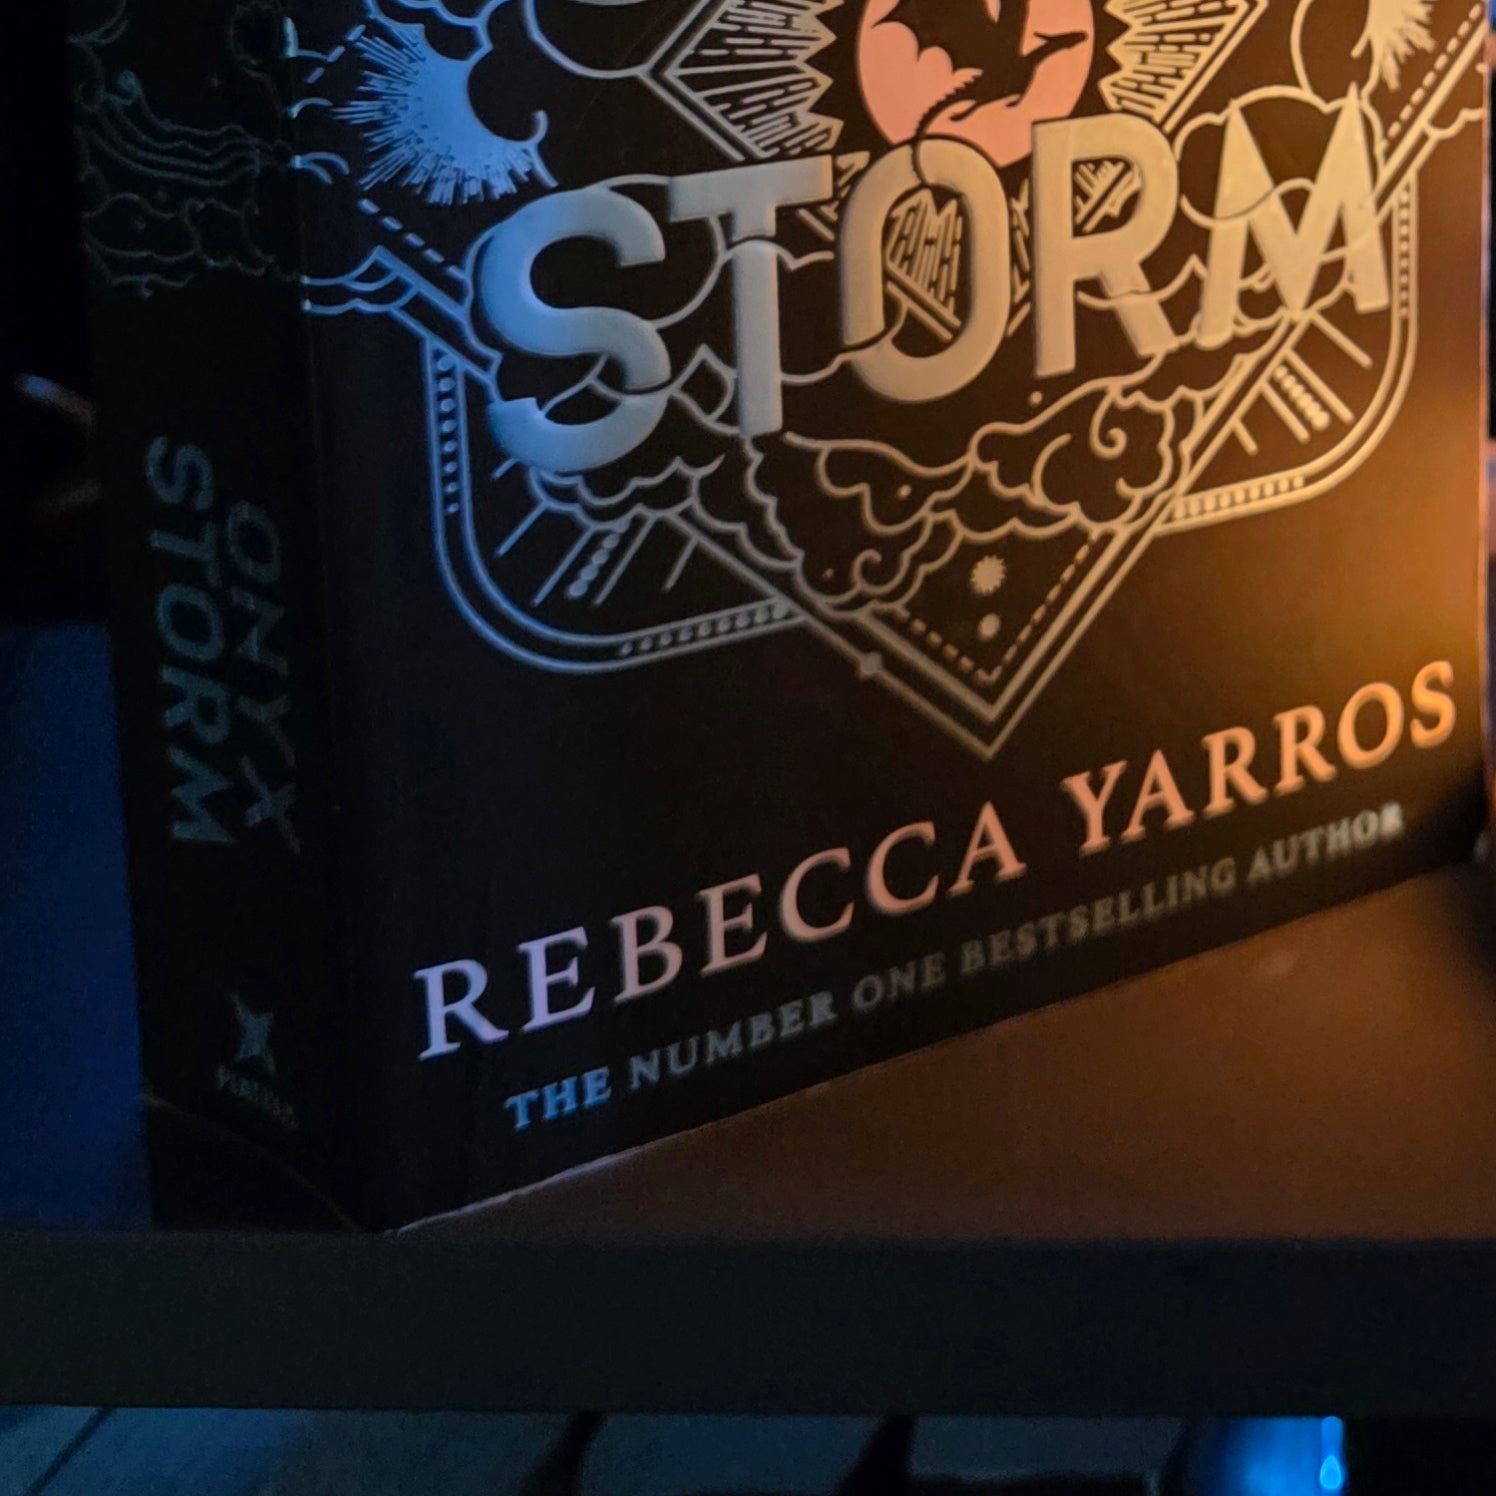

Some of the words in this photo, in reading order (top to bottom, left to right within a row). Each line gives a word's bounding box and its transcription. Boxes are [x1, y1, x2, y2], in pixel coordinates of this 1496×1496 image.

[472, 81, 1392, 473] STORM
[145, 434, 236, 846] STORM
[413, 799, 1027, 1061] REBECCA
[1060, 659, 1456, 858] YARROS
[505, 1064, 612, 1133] THE
[628, 989, 838, 1092] NUMBER
[852, 952, 949, 1016] ONE
[960, 854, 1237, 978] BESTSELLING
[1246, 802, 1404, 888] AUTHOR
